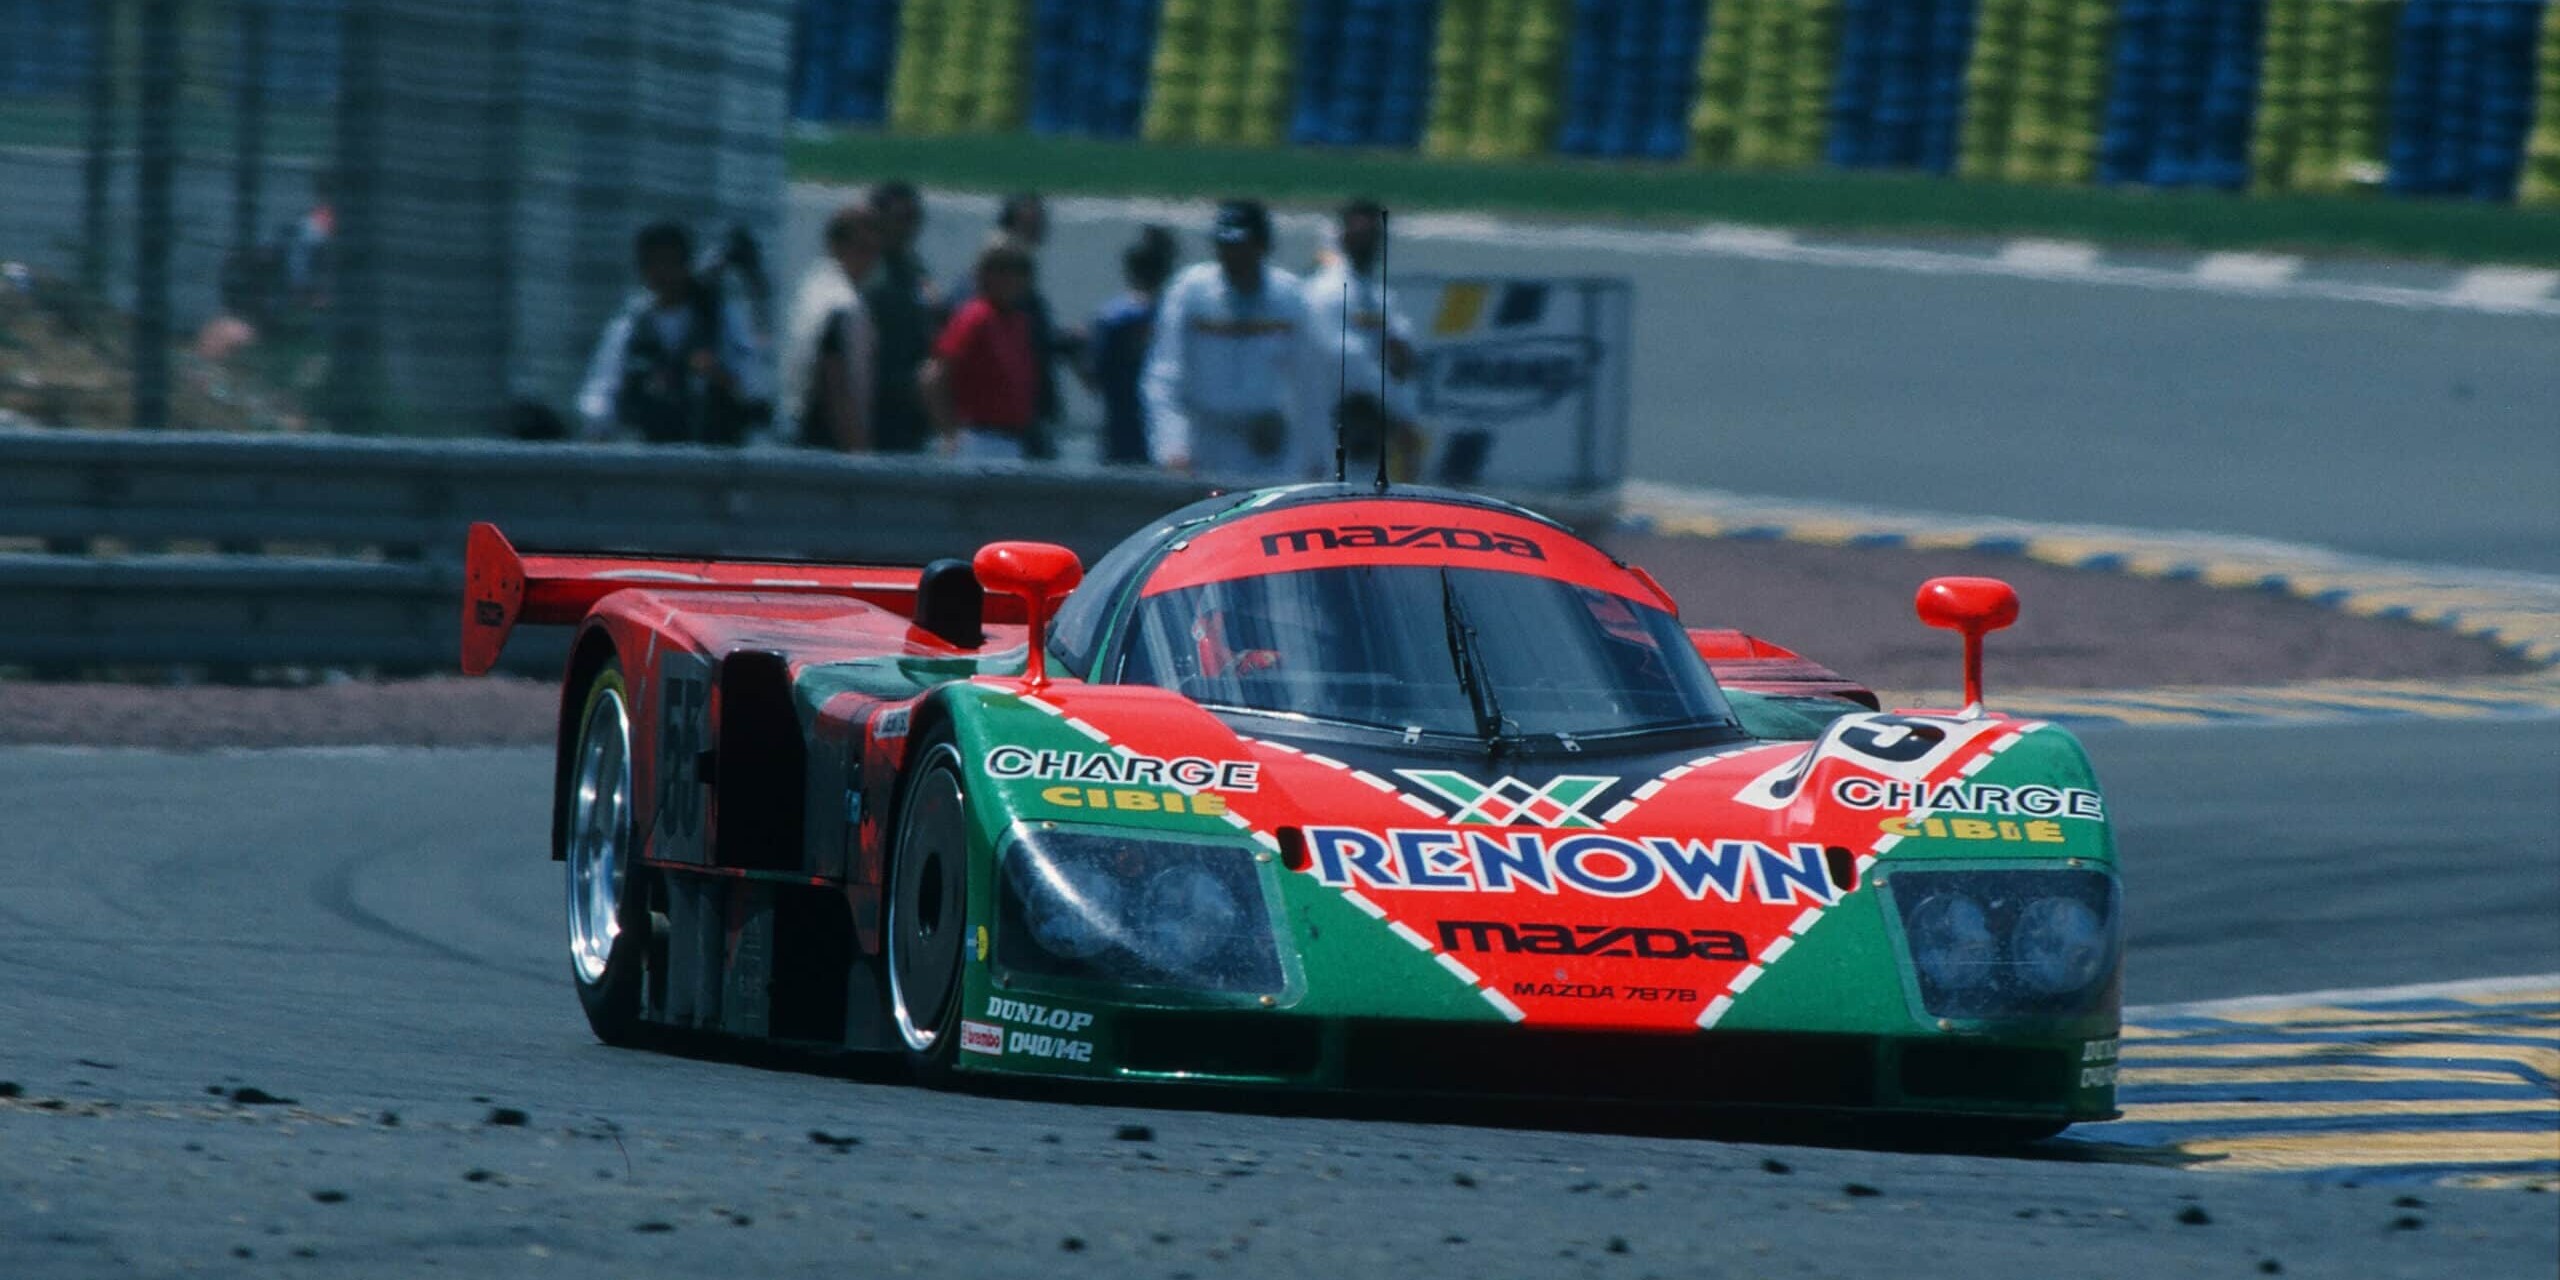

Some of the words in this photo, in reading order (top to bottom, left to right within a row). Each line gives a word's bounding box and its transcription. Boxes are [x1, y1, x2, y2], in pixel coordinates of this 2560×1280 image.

[1260, 524, 1547, 561] mazda
[984, 745, 1260, 792] CHARGE
[1832, 776, 2104, 822] CHARGE
[1303, 825, 1840, 906] RENOWN
[1437, 920, 1750, 962] mazda
[1513, 982, 1615, 999] MAZDA
[1623, 986, 1697, 1003] 787B
[986, 996, 1094, 1032] DUNLOP
